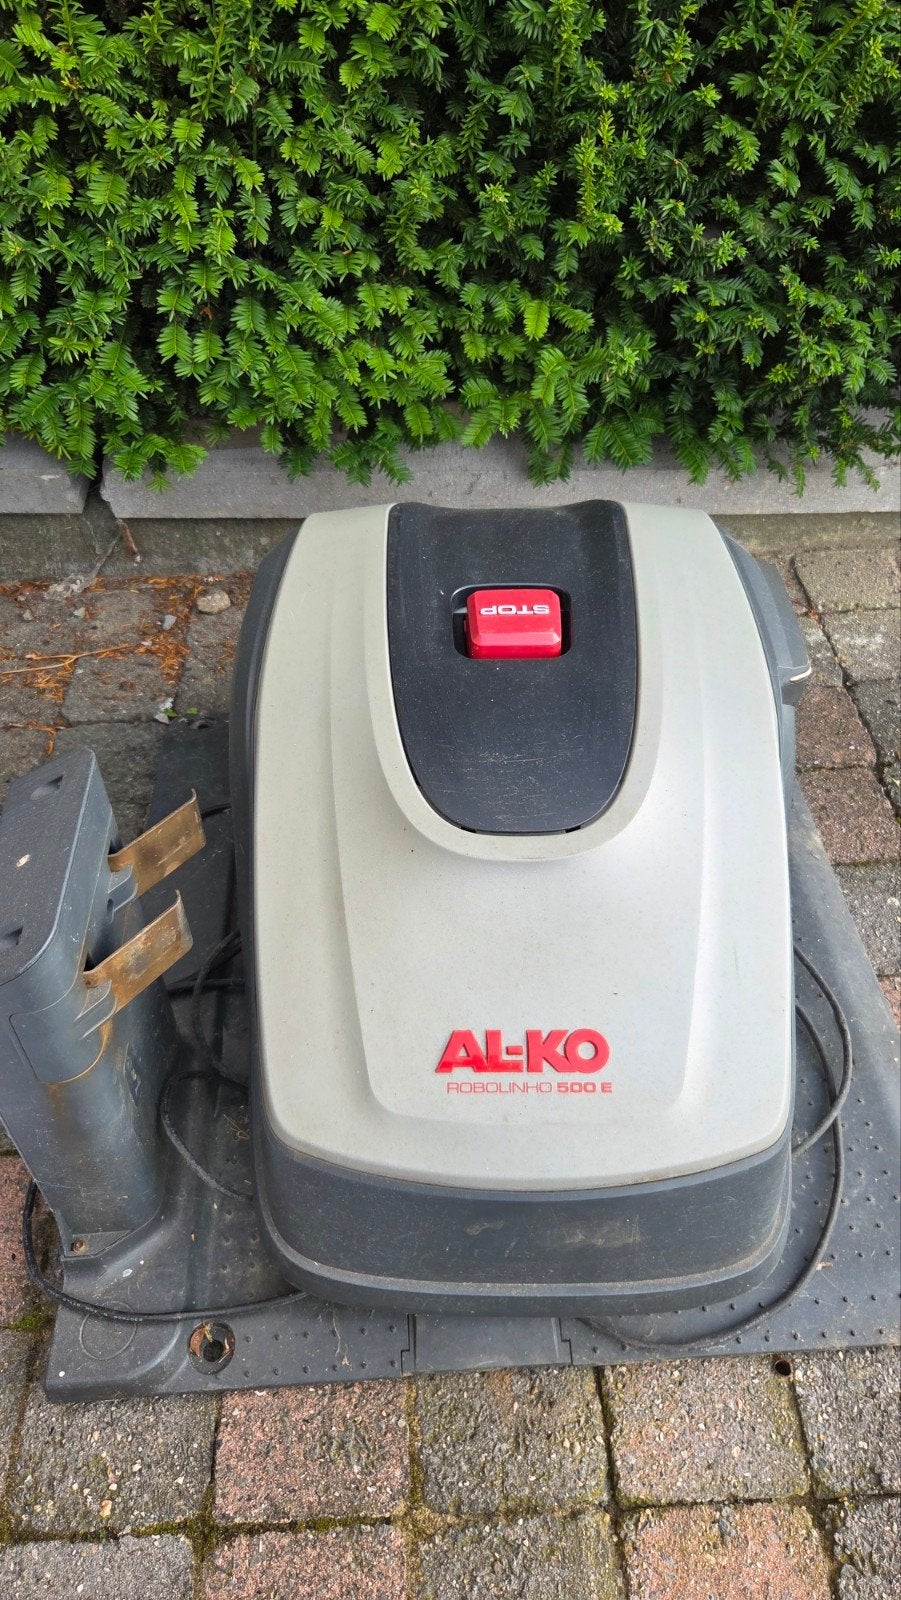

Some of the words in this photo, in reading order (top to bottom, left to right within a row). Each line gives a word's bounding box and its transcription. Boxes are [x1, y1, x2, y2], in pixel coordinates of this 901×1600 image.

[480, 604, 550, 615] STOP
[435, 1028, 610, 1073] AL-KO
[447, 1081, 553, 1094] ROBOLINHO
[556, 1081, 597, 1093] 500
[601, 1081, 612, 1093] E
